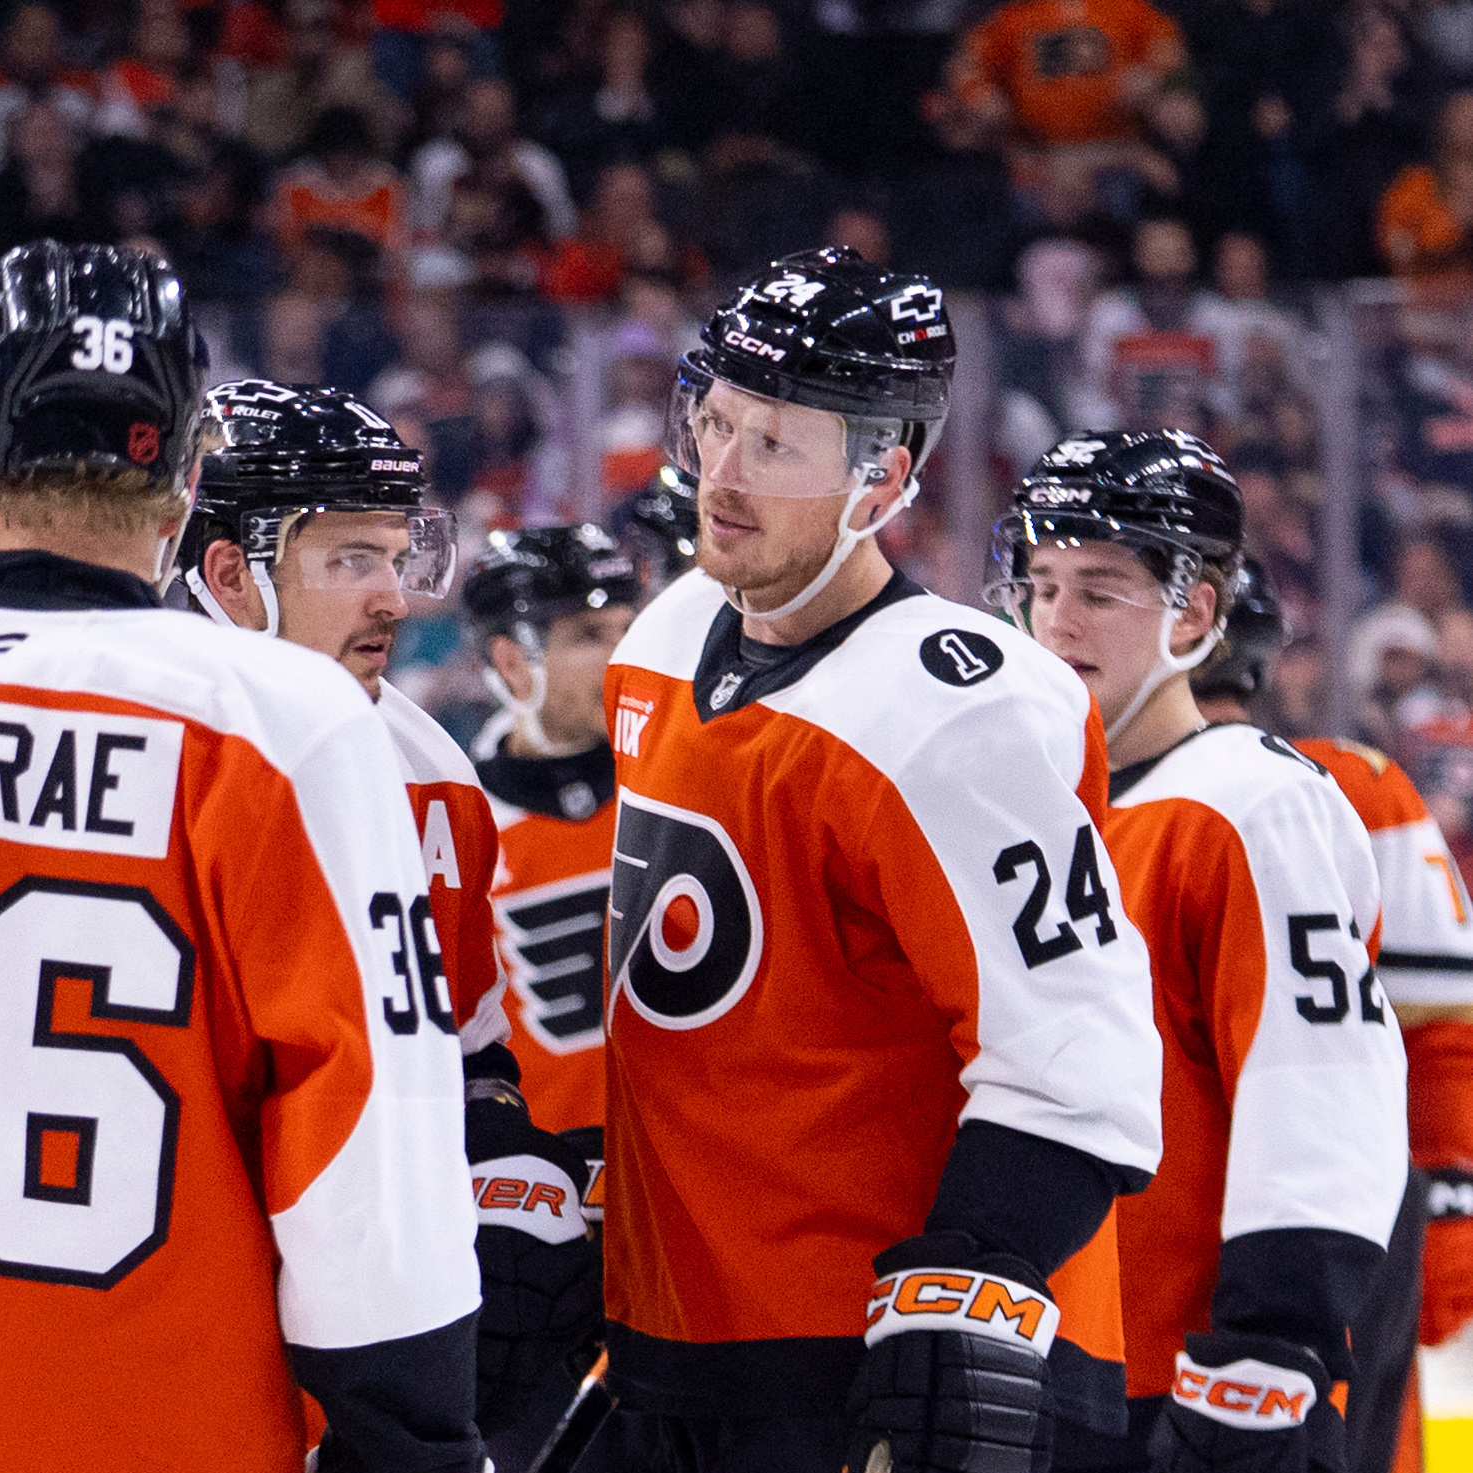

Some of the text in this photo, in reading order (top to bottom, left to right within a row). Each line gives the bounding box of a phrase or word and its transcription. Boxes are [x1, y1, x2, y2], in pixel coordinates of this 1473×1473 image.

[763, 273, 826, 307] 24
[72, 316, 134, 374] 36
[724, 330, 786, 363] CCM
[370, 458, 420, 473] BAUER
[939, 632, 989, 681] 1
[419, 799, 463, 889] A
[992, 823, 1118, 970] 24
[368, 891, 459, 1035] 36
[1174, 1369, 1308, 1424] CCM
